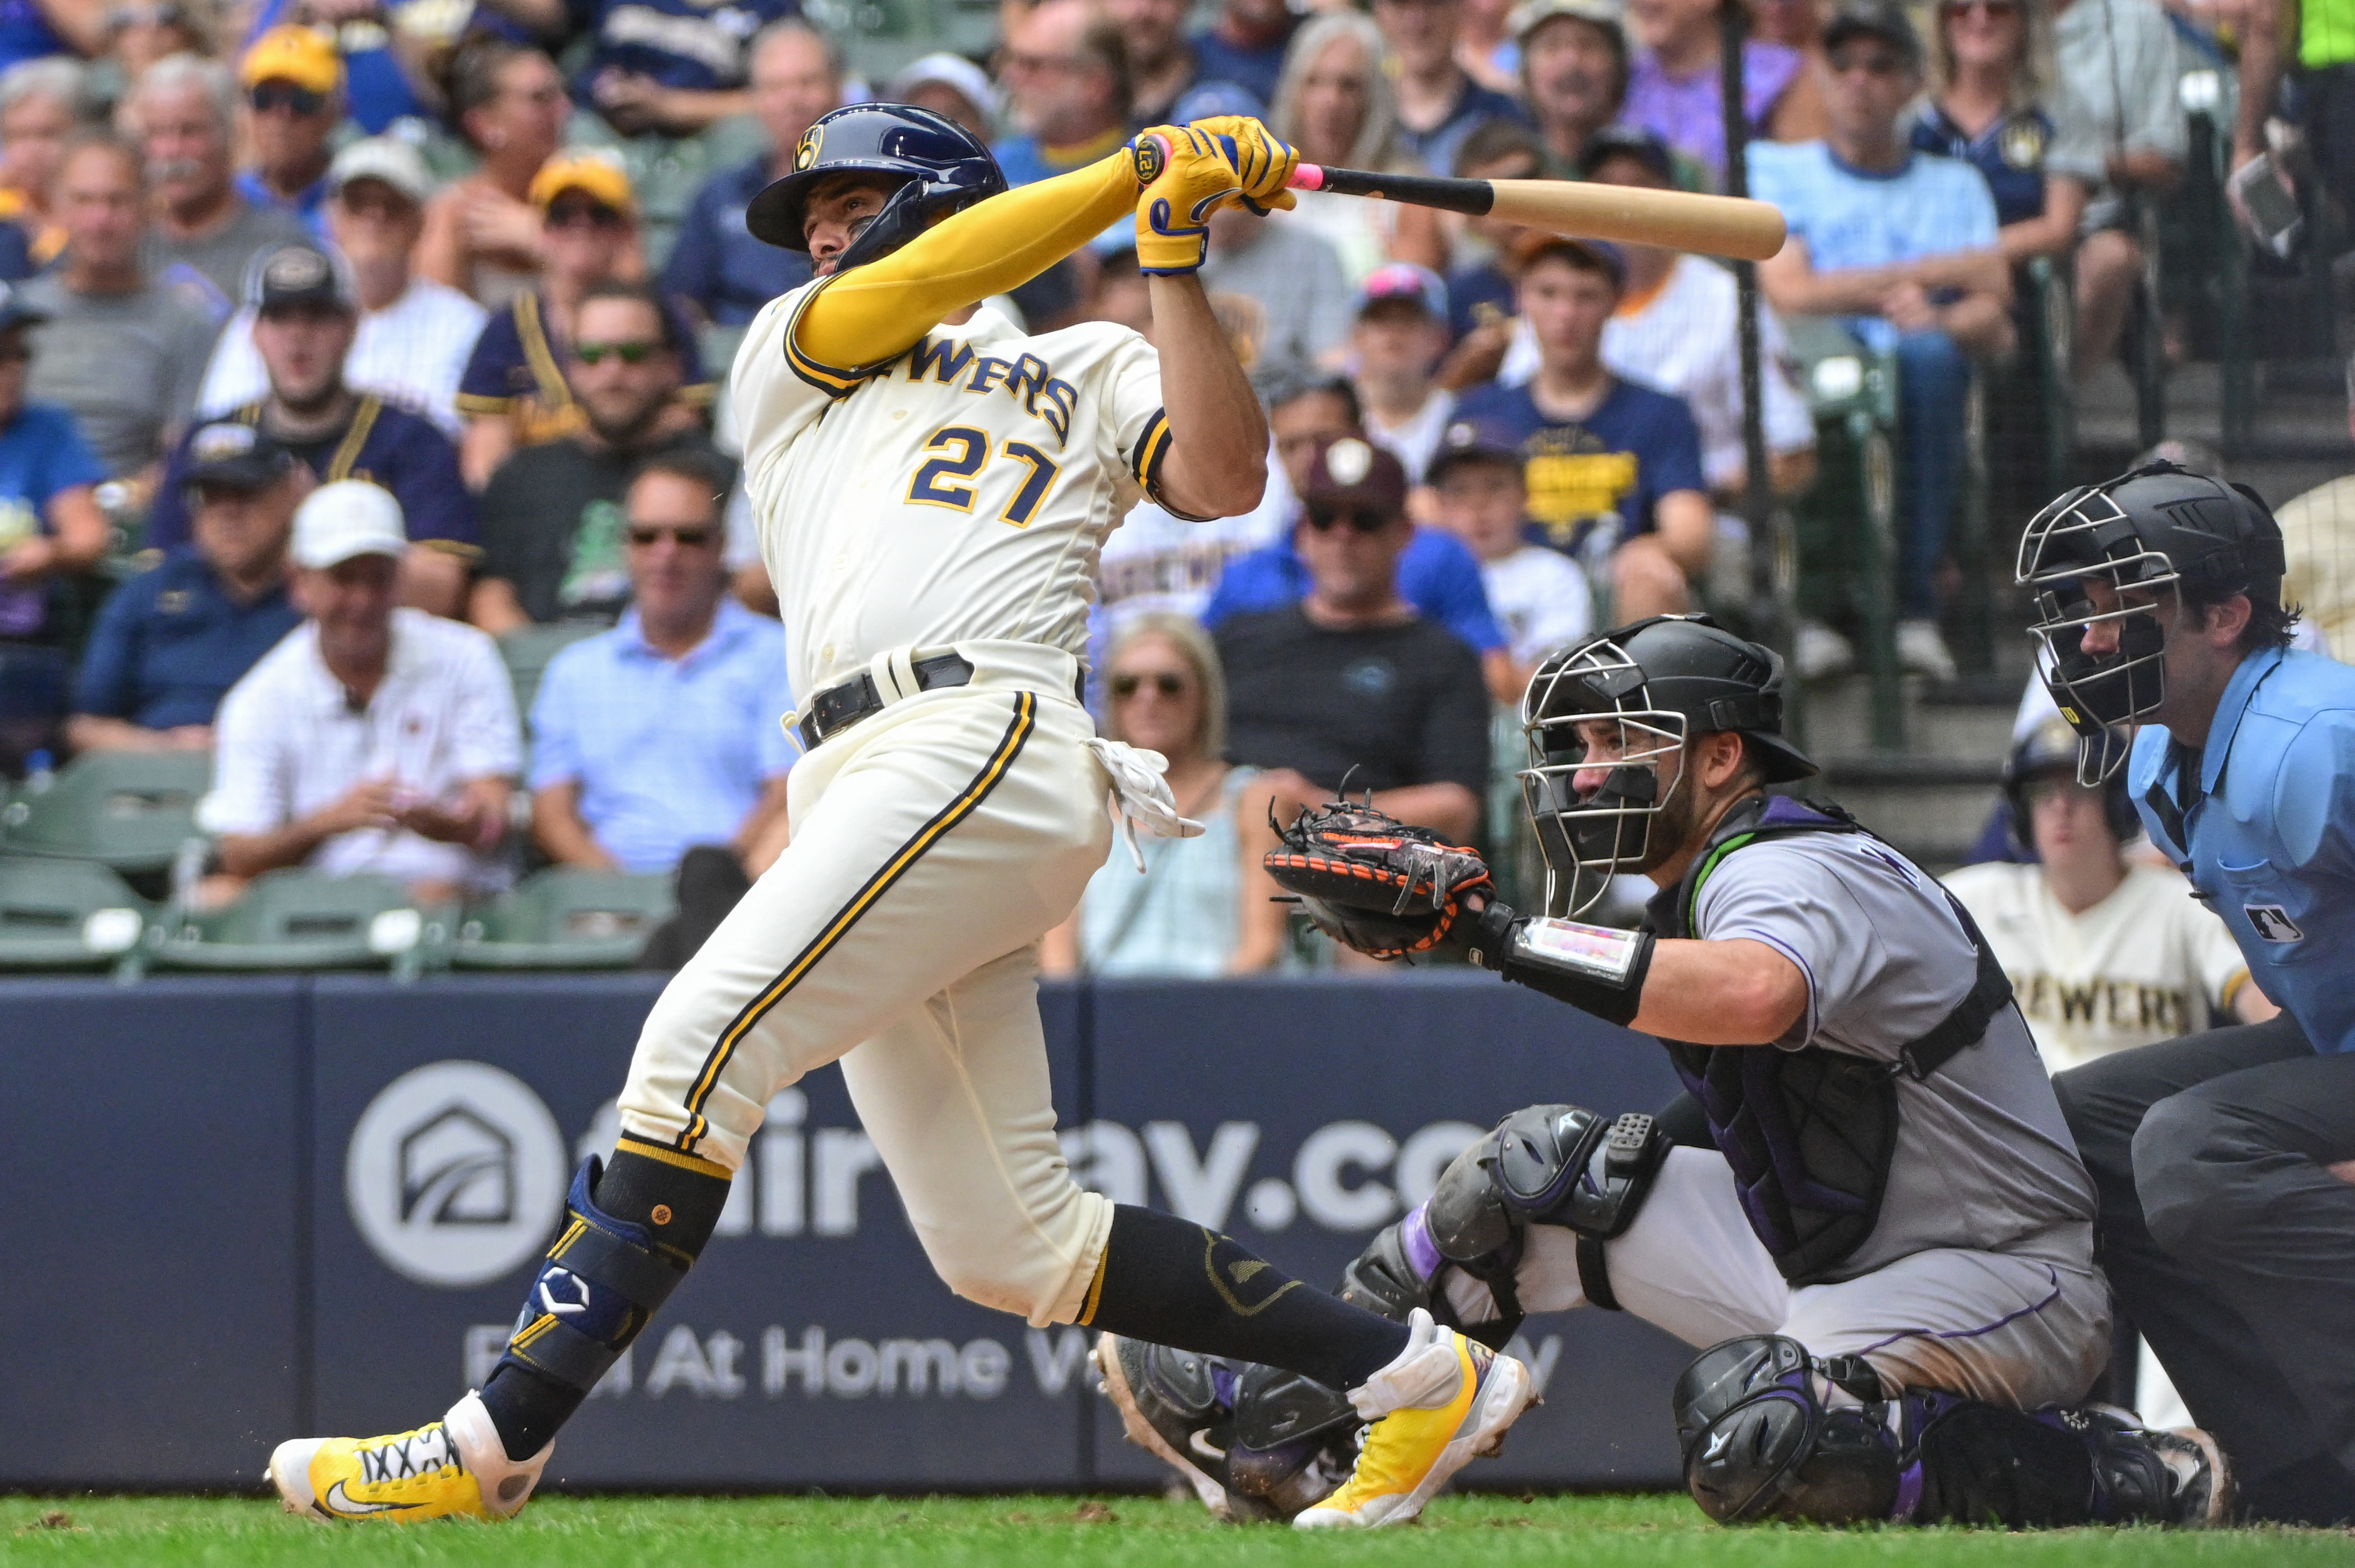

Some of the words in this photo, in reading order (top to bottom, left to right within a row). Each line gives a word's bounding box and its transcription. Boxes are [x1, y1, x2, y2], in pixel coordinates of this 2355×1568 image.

[1139, 150, 1153, 171] 27
[903, 423, 1062, 529] 27
[646, 1324, 746, 1397] At
[763, 1325, 1010, 1397] Home
